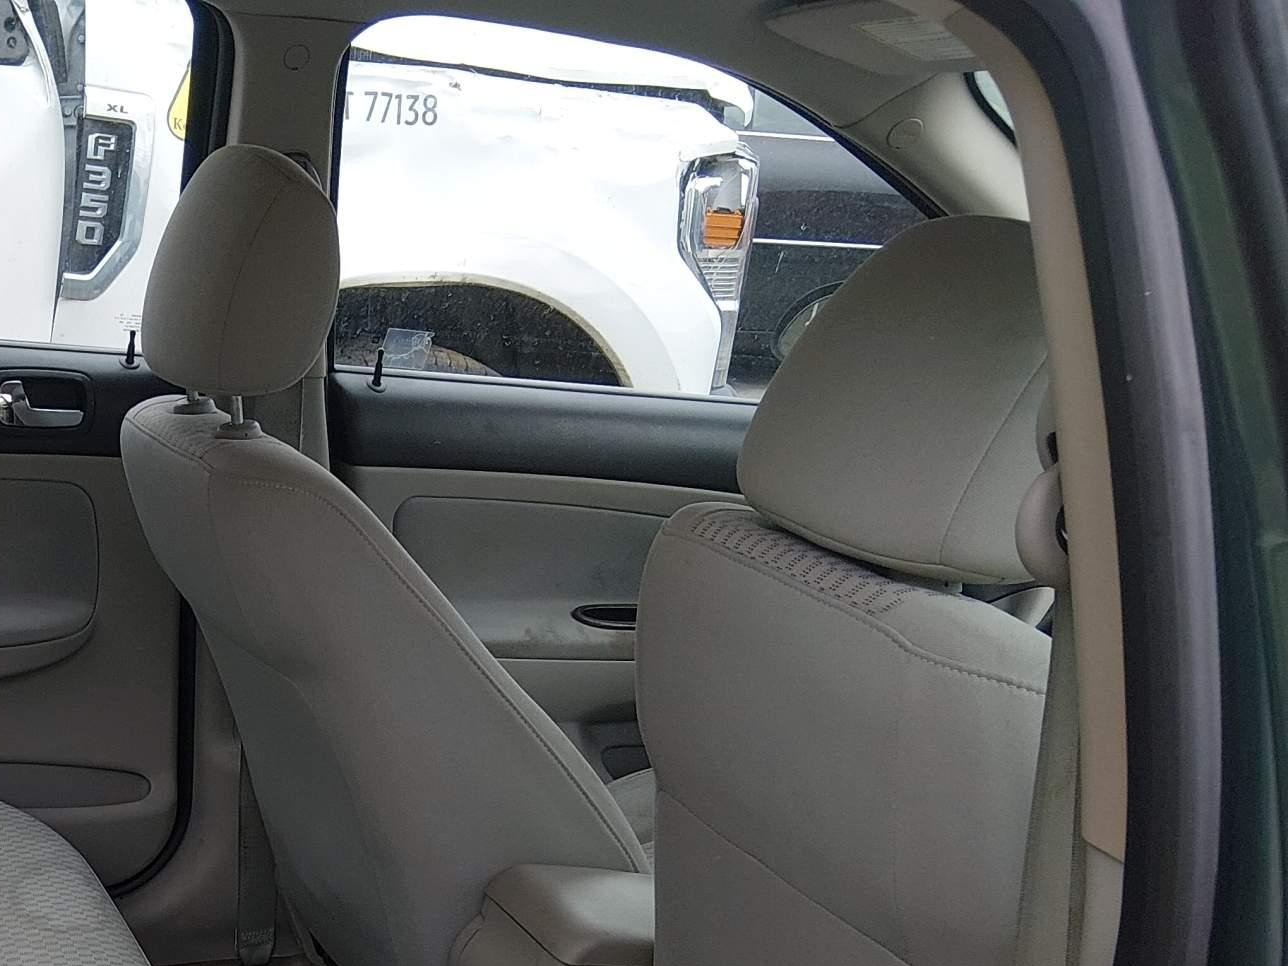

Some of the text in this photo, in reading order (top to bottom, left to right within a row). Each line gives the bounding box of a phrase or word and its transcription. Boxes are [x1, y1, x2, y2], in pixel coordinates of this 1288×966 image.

[106, 103, 129, 114] XL
[364, 91, 438, 126] 77138
[75, 132, 118, 245] F350
